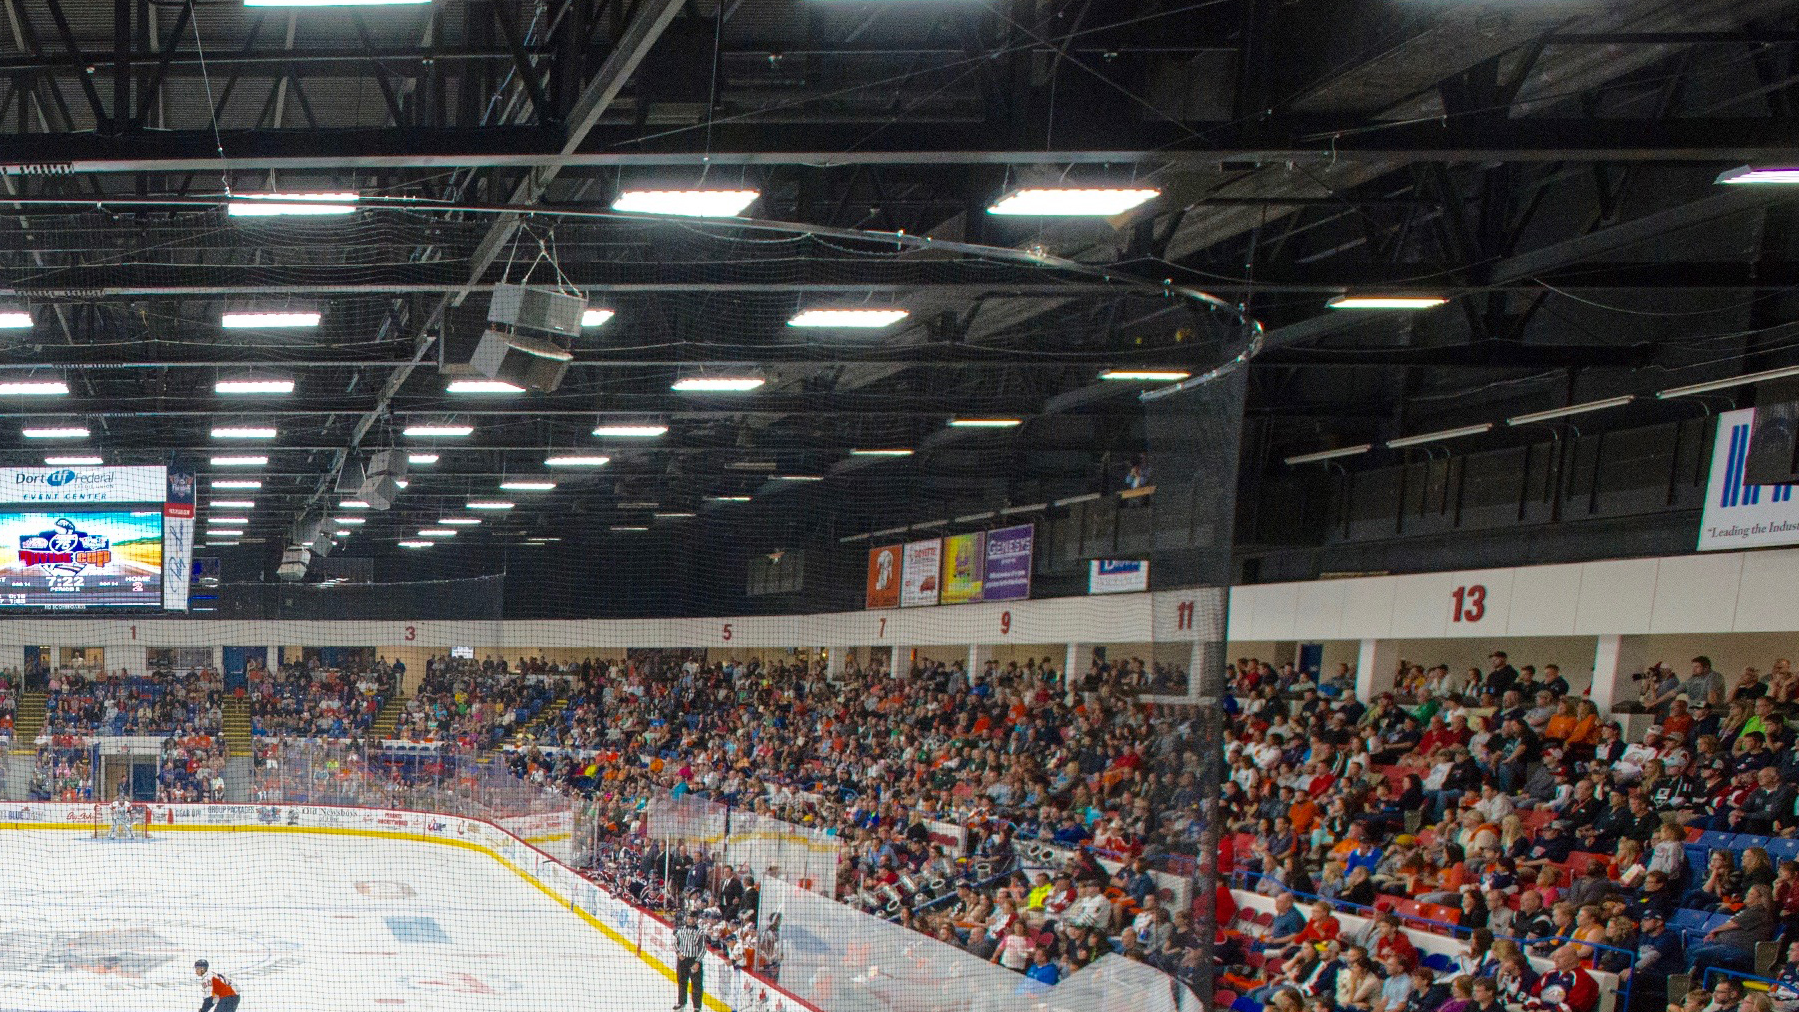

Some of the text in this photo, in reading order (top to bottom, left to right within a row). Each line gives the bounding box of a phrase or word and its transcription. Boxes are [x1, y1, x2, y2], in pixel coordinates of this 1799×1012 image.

[15, 473, 45, 484] Dort
[73, 472, 114, 484] Federal
[1751, 522, 1767, 534] the
[988, 536, 1032, 554] GENESYS
[46, 577, 84, 587] 7:22
[132, 582, 143, 592] 2
[1452, 585, 1486, 622] 13
[1001, 611, 1011, 634] 9
[1177, 601, 1194, 629] 11
[130, 625, 136, 641] 1
[405, 625, 415, 641] 3
[722, 624, 732, 641] 5
[879, 618, 886, 638] 7
[8, 811, 24, 820] BLUE
[207, 805, 256, 814] GROUP PACKAGES
[302, 807, 358, 818] Old Newsboys
